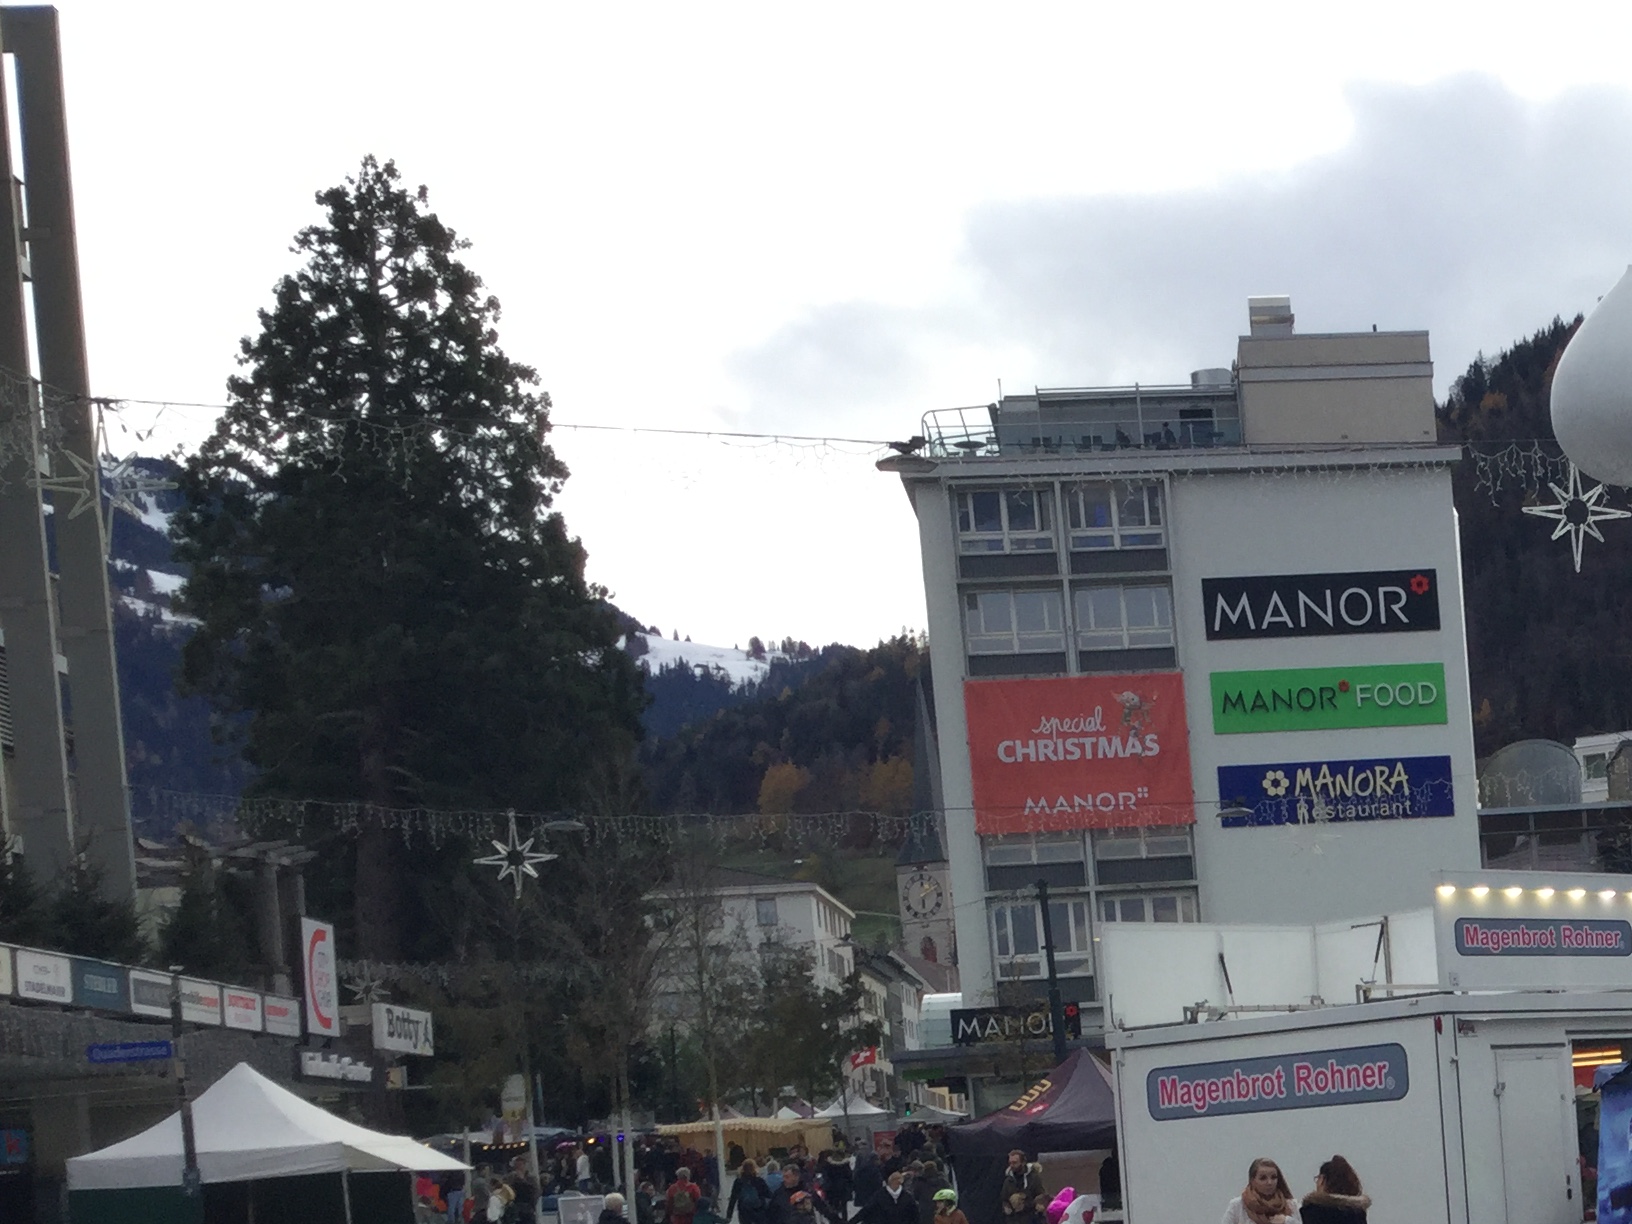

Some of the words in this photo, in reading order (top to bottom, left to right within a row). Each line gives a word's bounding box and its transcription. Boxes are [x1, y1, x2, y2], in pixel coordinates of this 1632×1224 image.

[1213, 586, 1410, 633] MANOR
[1222, 686, 1340, 714] MANOR
[1355, 681, 1438, 708] FOOD
[1031, 704, 1107, 735] special
[996, 732, 1161, 764] CHRISTMAS
[1295, 764, 1410, 800] MANORA
[1023, 791, 1137, 816] MANOR
[1296, 799, 1413, 821] Restaurant
[1463, 924, 1556, 953] Magenbrot
[385, 1007, 423, 1050] Botty
[958, 1011, 1060, 1040] MANO
[1157, 1066, 1287, 1113] Magenbrot
